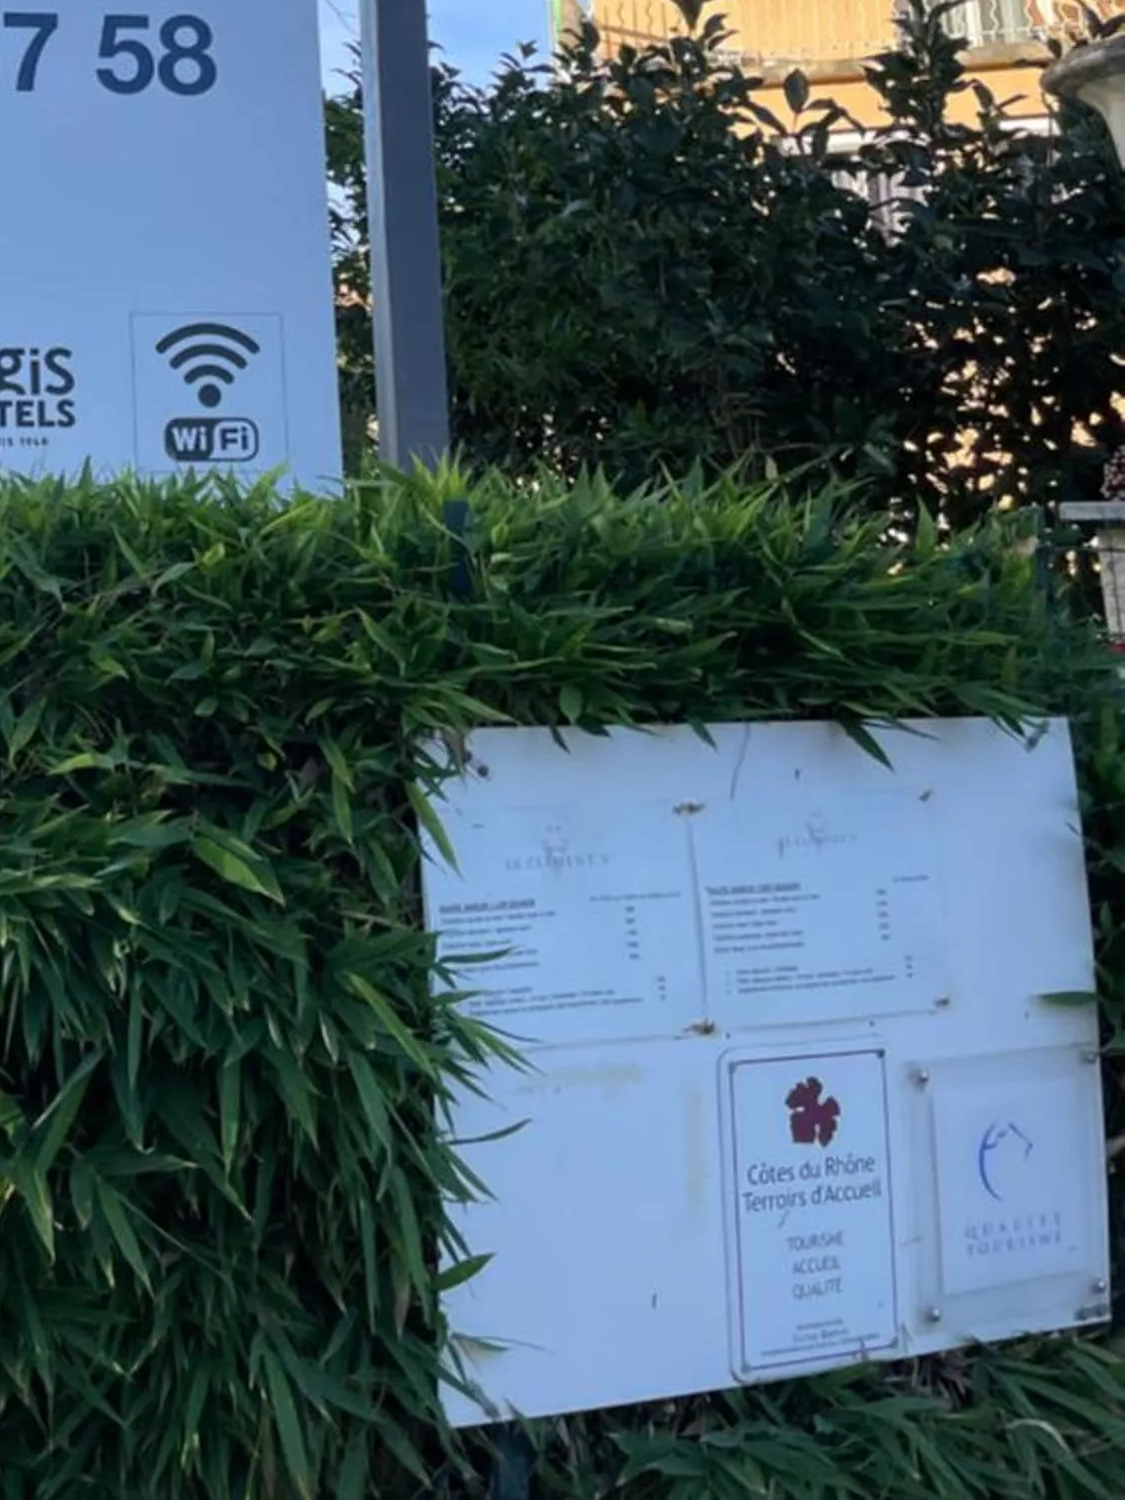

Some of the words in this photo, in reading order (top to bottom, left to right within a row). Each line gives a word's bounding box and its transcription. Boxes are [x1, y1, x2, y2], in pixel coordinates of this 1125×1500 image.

[95, 13, 218, 97] 58
[746, 1161, 796, 1186] Côtes
[798, 1161, 822, 1181] du
[824, 1151, 877, 1177] Rhône
[742, 1190, 808, 1213] Terroirs
